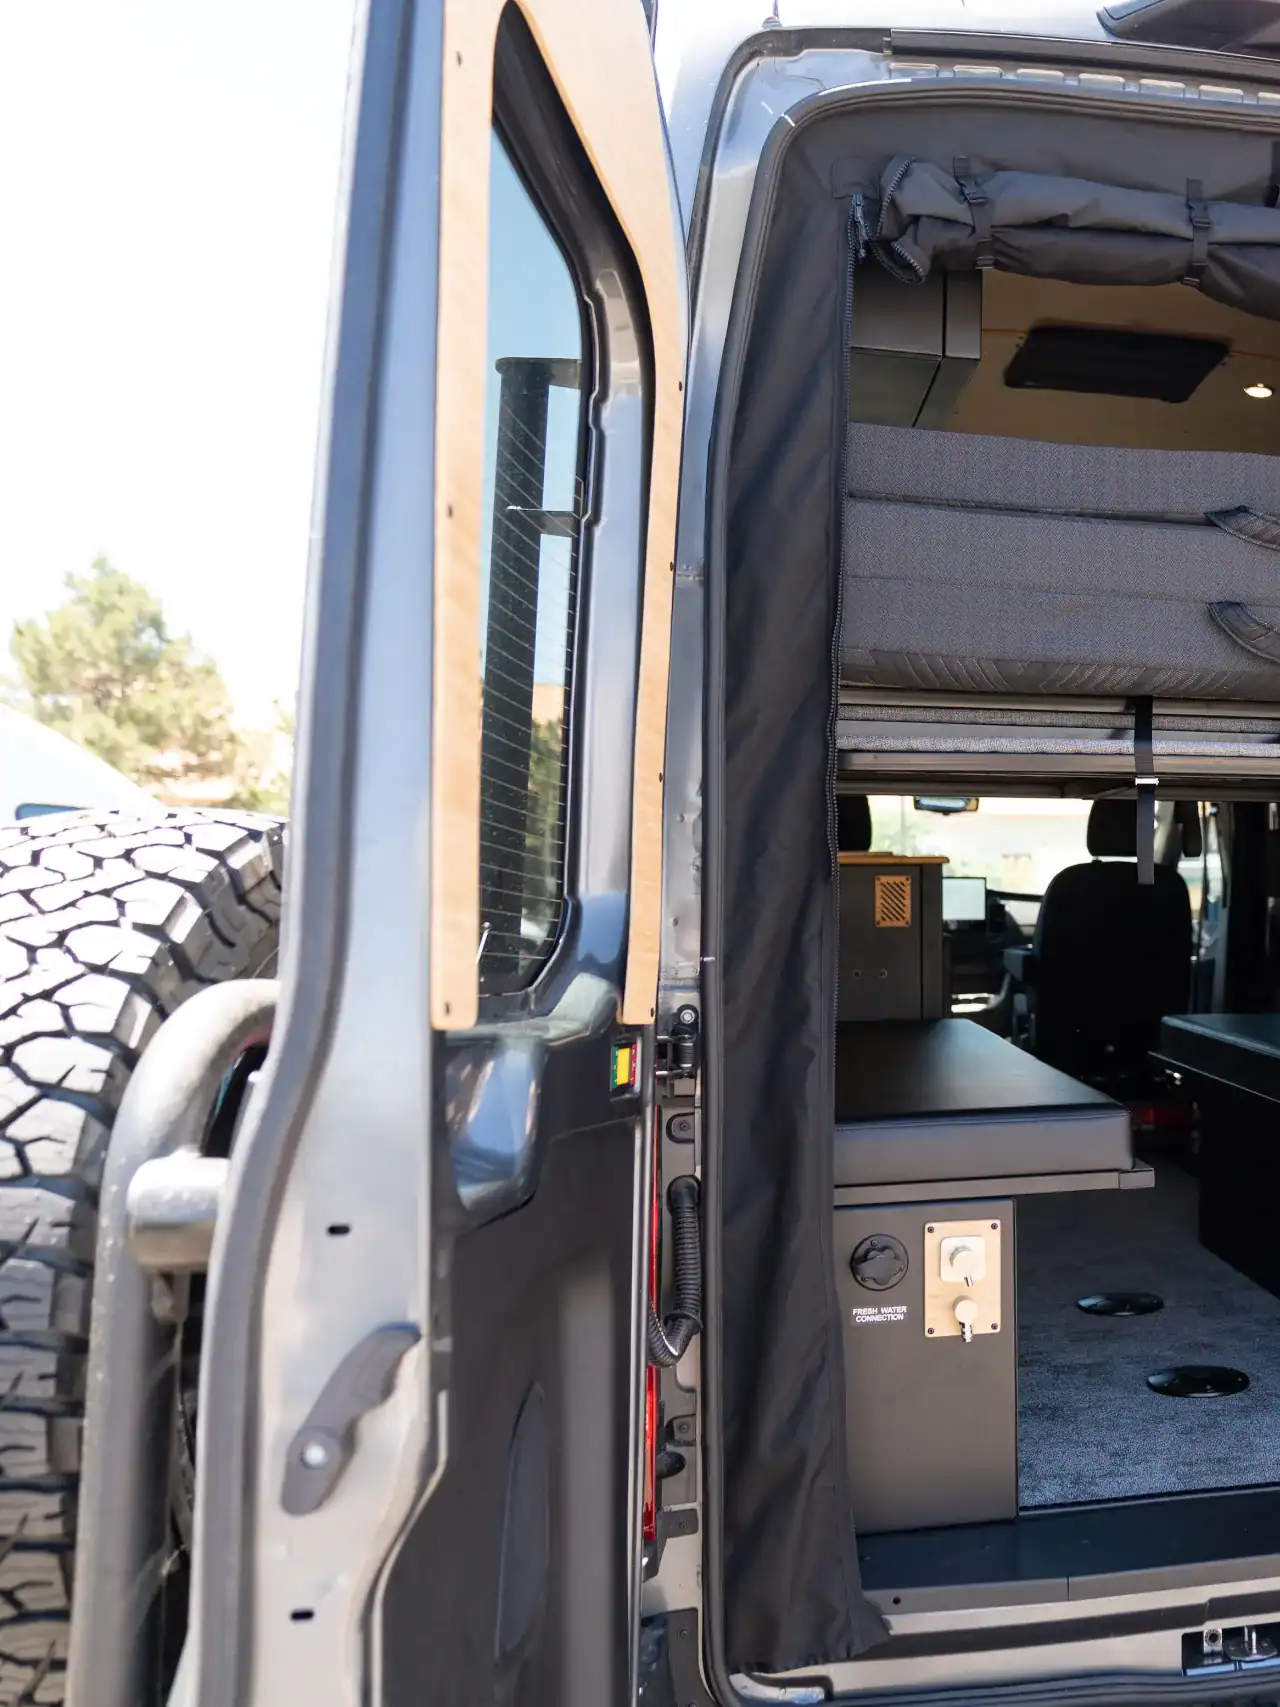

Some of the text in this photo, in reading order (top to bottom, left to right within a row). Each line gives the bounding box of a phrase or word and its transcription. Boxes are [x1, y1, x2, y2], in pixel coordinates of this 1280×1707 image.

[852, 1305, 908, 1316] FRESH WATER
[855, 1313, 904, 1323] CONNECTION
